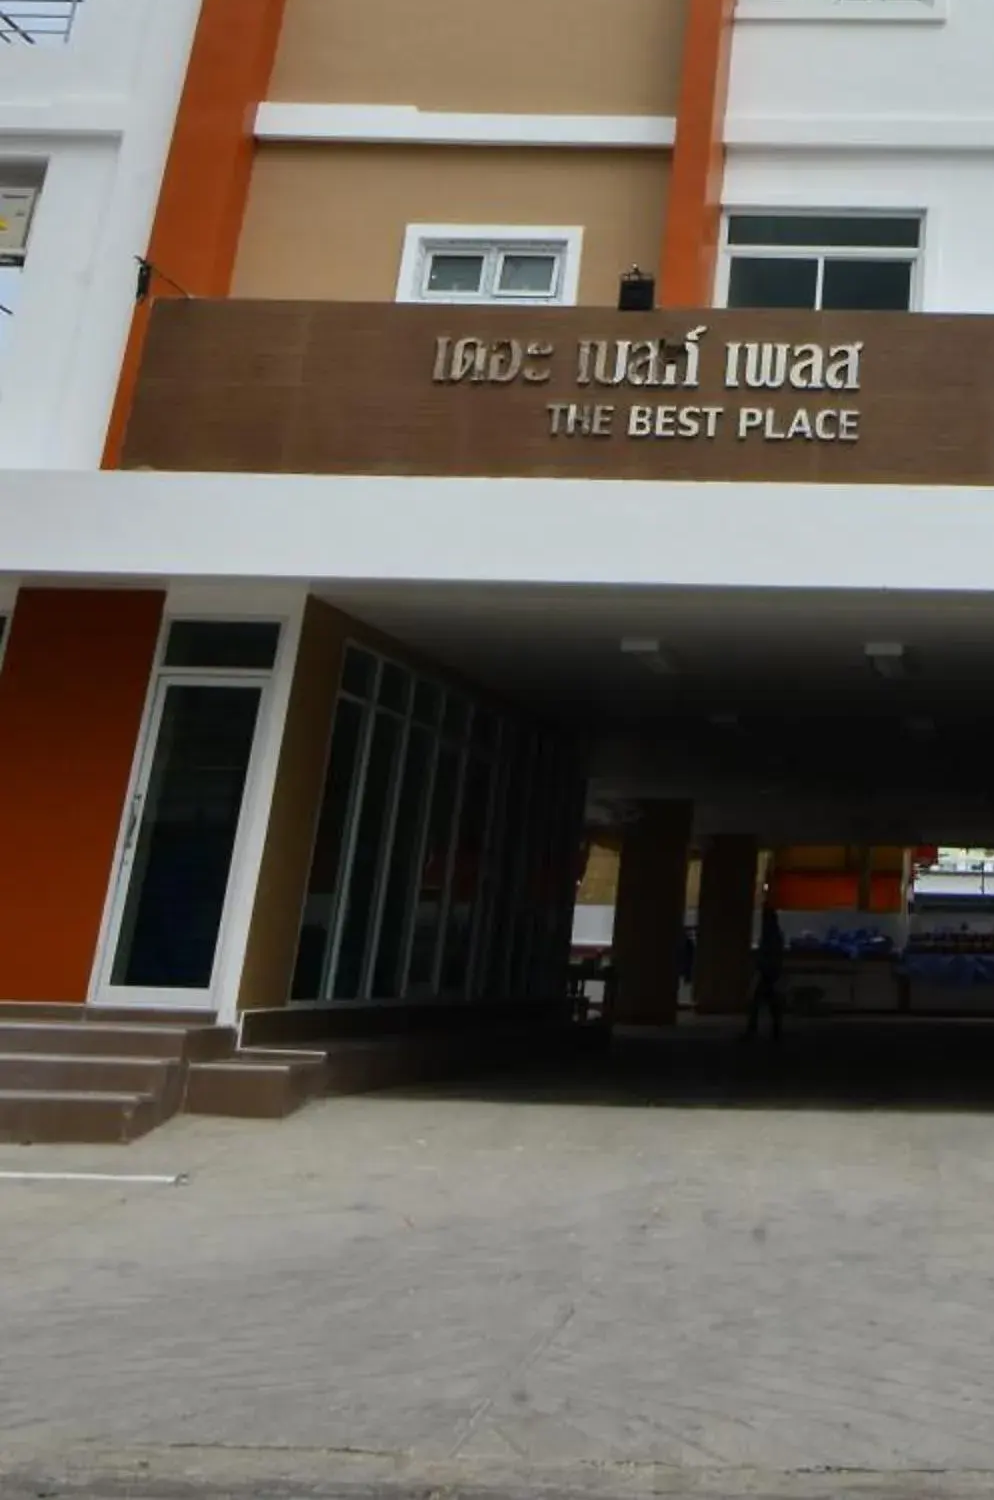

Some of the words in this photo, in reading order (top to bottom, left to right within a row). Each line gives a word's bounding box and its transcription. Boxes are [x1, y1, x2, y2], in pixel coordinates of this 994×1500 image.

[431, 336, 555, 383] เดอะ
[725, 340, 865, 389] เพลส
[546, 403, 614, 436] THE
[628, 405, 724, 438] BEST
[739, 406, 861, 441] PLACE
